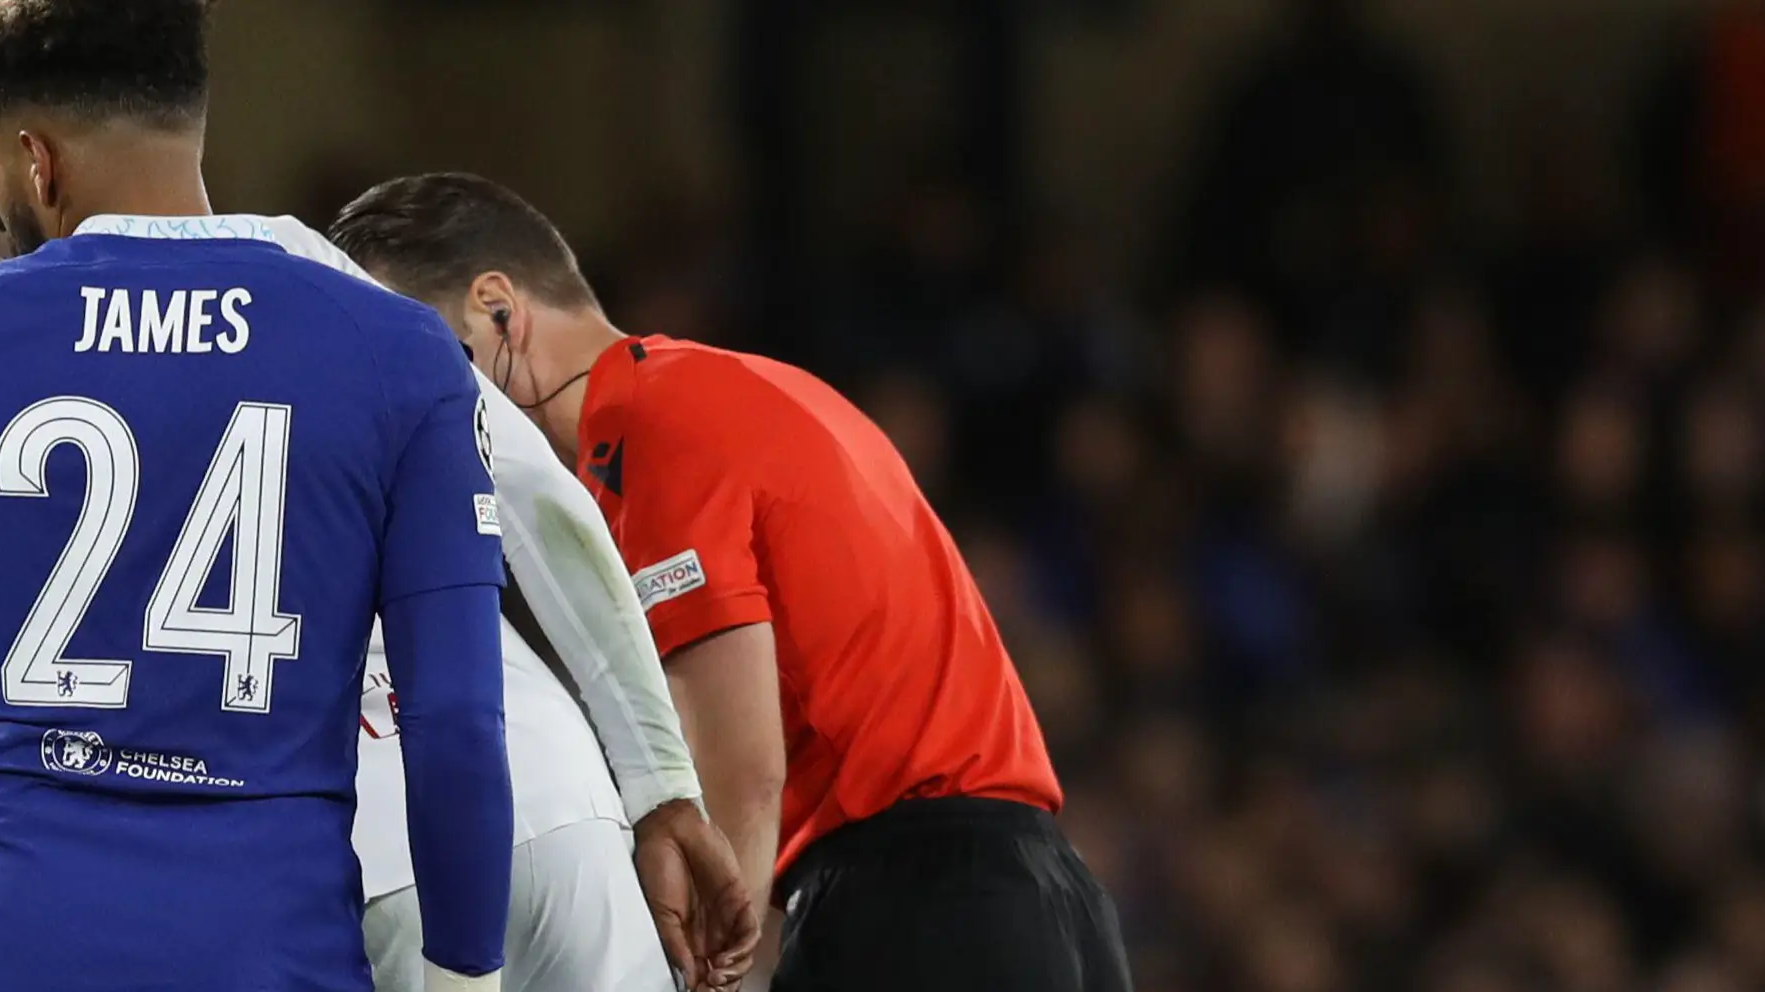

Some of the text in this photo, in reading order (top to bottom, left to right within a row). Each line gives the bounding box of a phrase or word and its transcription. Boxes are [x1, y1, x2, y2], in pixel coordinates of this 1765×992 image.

[74, 287, 252, 353] JAMES
[115, 760, 245, 787] FOUNDATION
[120, 749, 208, 775] CHELSEA
